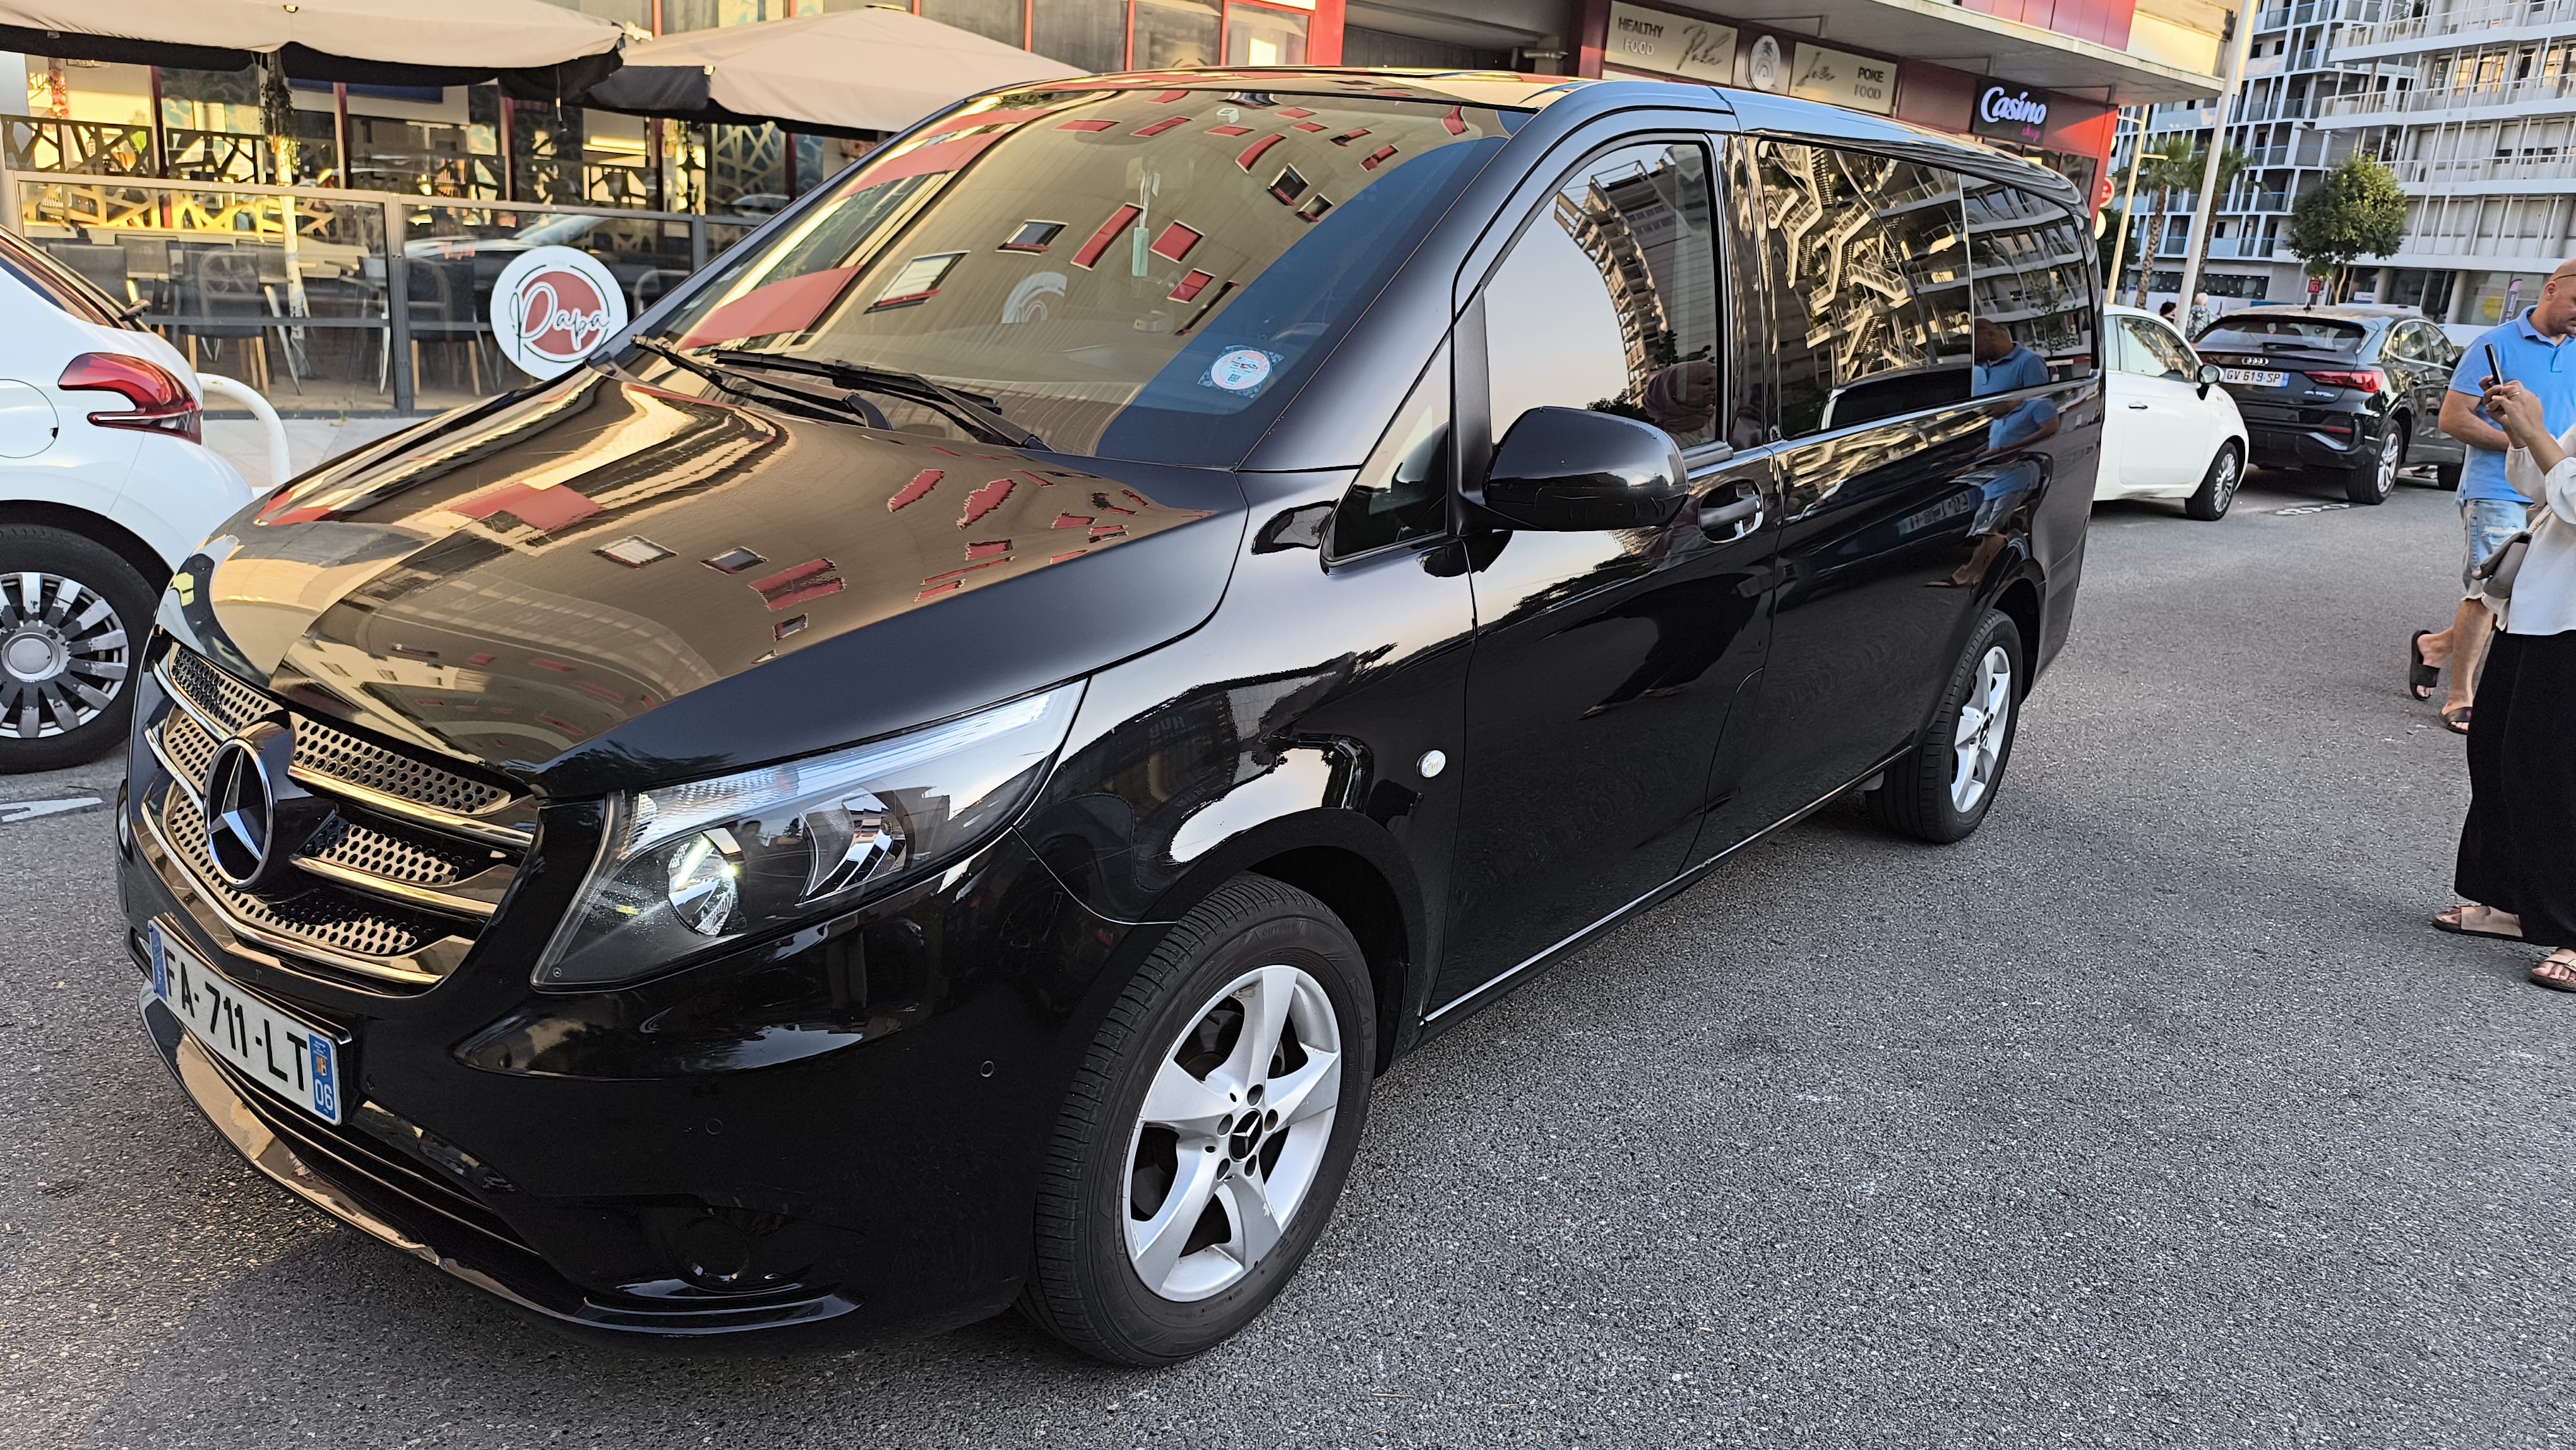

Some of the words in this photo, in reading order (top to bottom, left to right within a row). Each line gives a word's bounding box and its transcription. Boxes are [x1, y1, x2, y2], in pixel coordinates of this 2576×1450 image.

[1618, 16, 1664, 38] HEALTHY
[1623, 37, 1655, 56] FOOD
[1857, 66, 1884, 83] POKE
[1854, 84, 1881, 100] FOOD
[1981, 87, 2047, 124] Casino
[509, 285, 611, 361] Papa
[314, 1079, 334, 1111] 06
